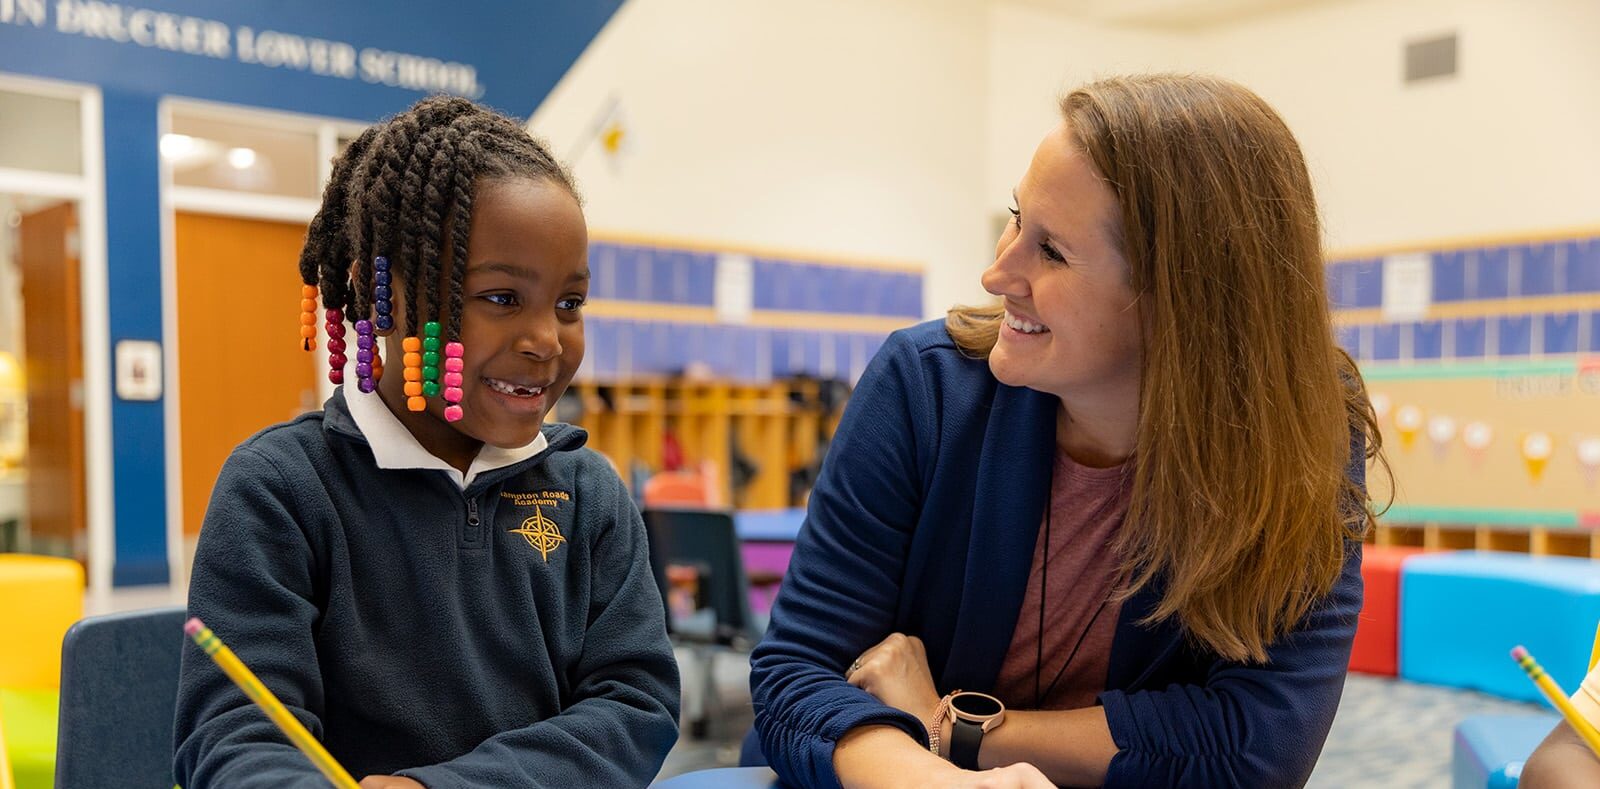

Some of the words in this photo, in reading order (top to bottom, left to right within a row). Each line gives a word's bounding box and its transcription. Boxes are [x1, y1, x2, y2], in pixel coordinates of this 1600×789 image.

[236, 25, 358, 79] LOWER
[359, 47, 485, 99] SCHOOL
[542, 490, 570, 501] Roads
[514, 499, 558, 507] Academy
